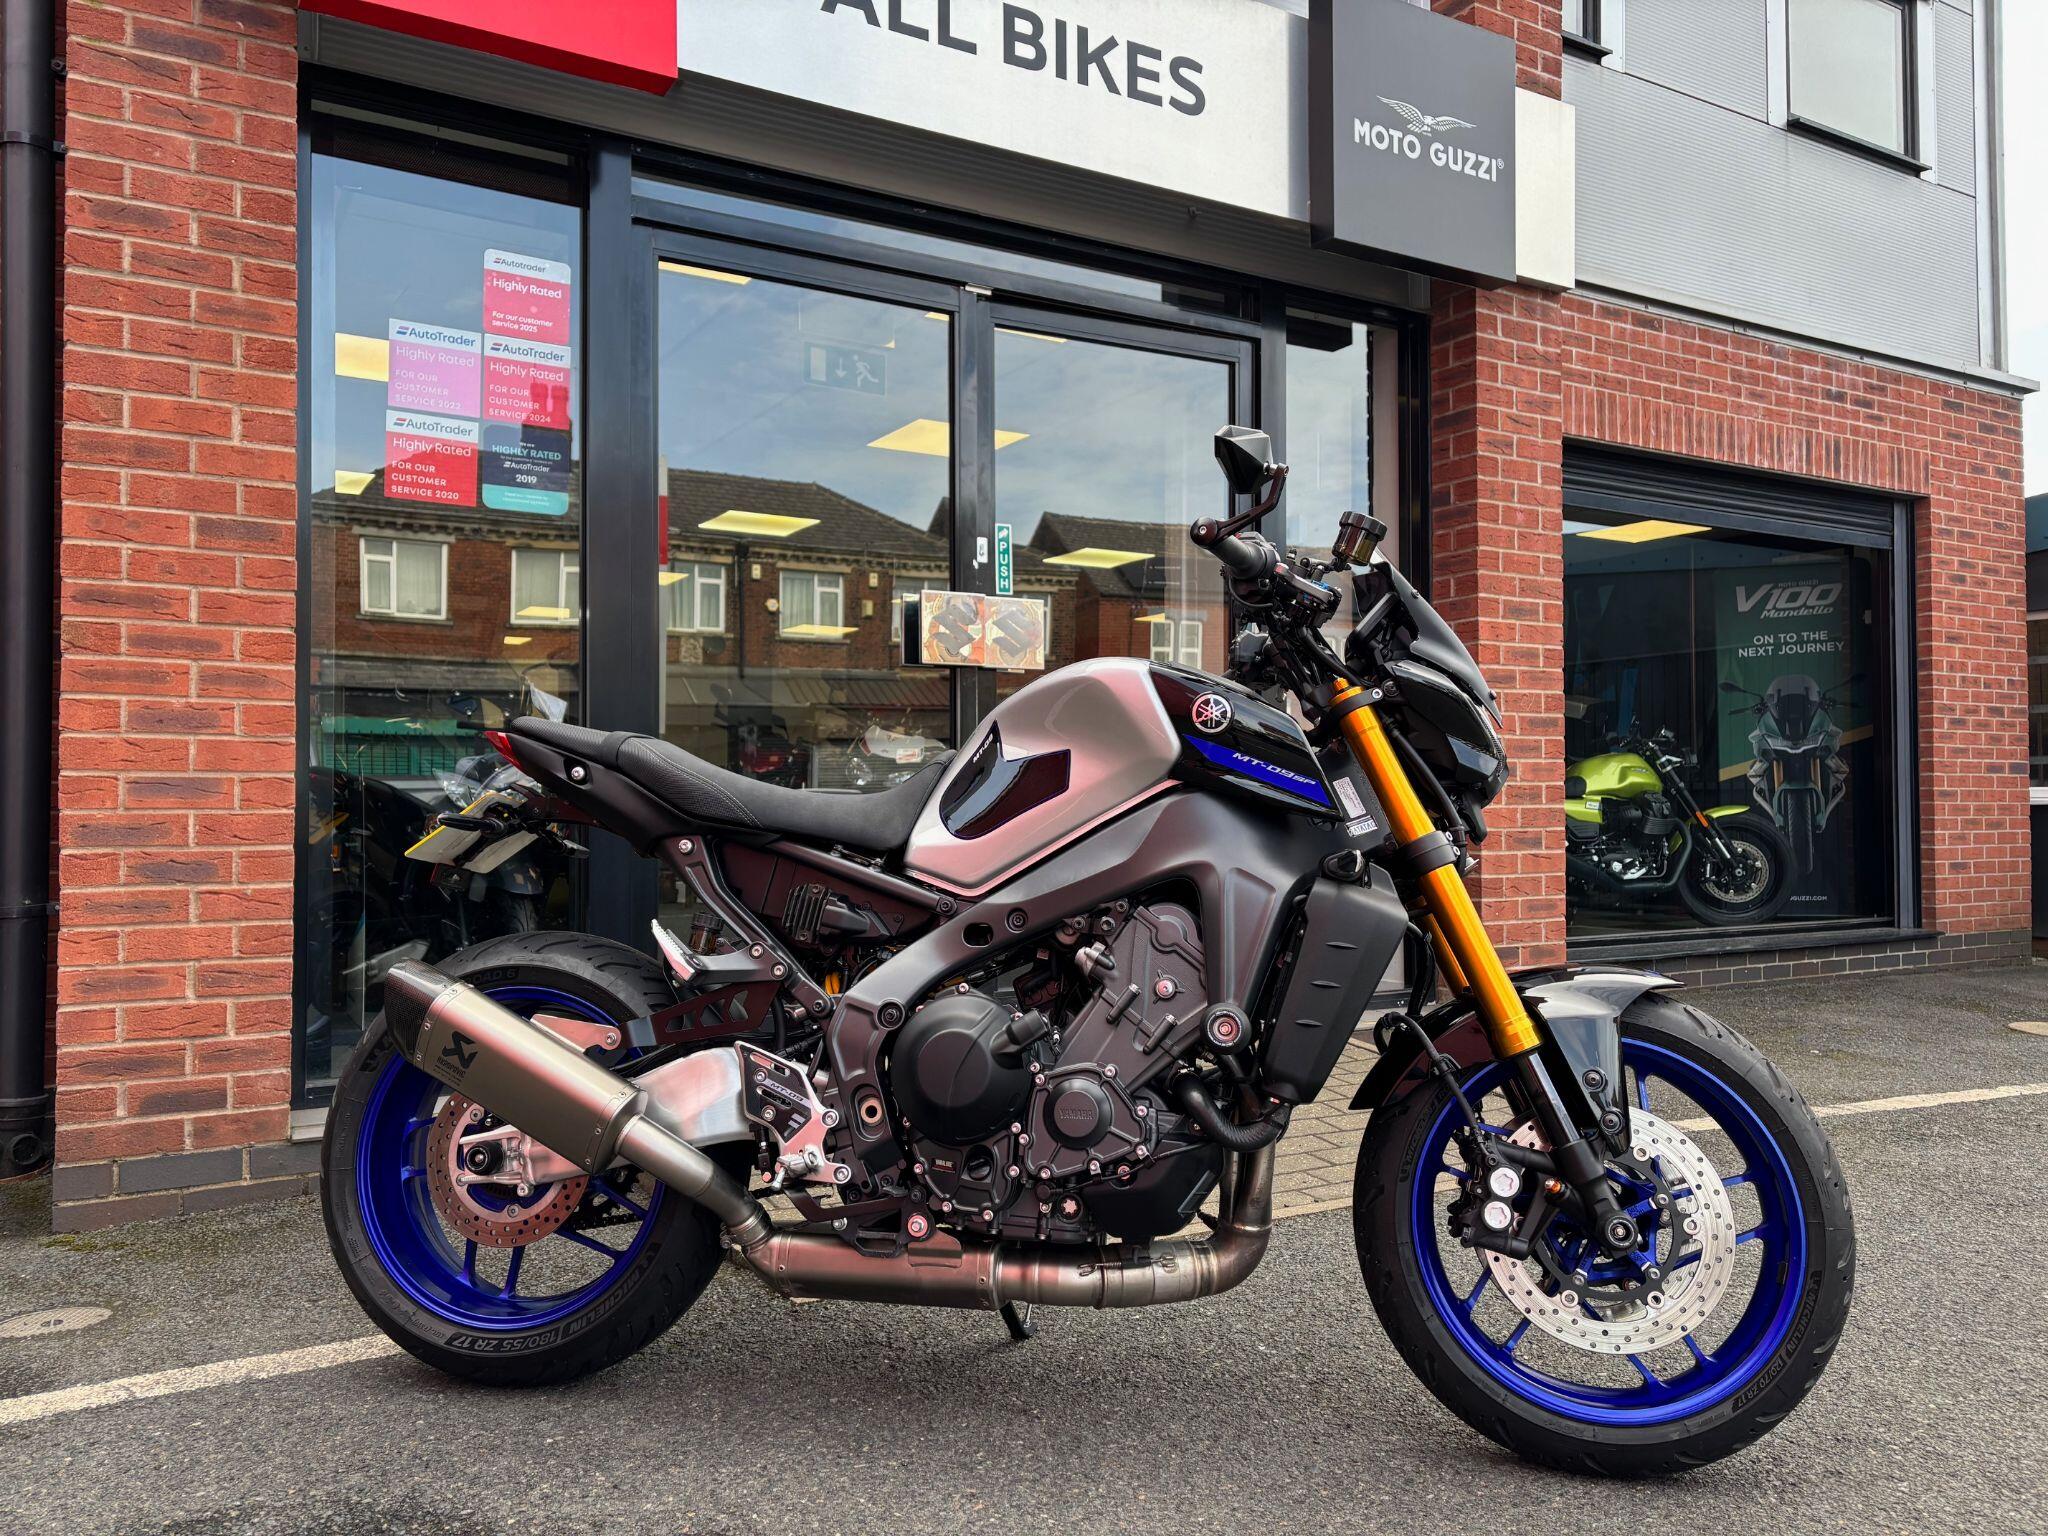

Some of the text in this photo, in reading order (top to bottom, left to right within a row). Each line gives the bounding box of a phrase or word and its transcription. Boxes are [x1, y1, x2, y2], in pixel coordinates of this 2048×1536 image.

[1003, 3, 1206, 117] BIKES
[1353, 117, 1422, 160] MOTO
[493, 277, 562, 299] Highly Rated
[492, 320, 519, 329] service
[518, 315, 553, 327] customer
[409, 327, 476, 347] AutoTrader
[396, 345, 475, 367] Highly Rated
[502, 344, 565, 361] AutoTrader
[395, 369, 438, 382] FOR OUR
[490, 361, 564, 382] Highly Rated
[394, 382, 449, 396] CUSTOMER
[489, 384, 529, 396] FOR OUR
[394, 394, 435, 406] SERVICE
[489, 396, 540, 410] CUSTOMER
[489, 408, 551, 423] SERVICE 2024
[406, 418, 473, 436] AutoTrader
[393, 437, 472, 457] Highly Rated
[492, 444, 529, 456] HIGHLY
[530, 450, 562, 460] RATED
[391, 460, 436, 473] FOR OUR
[510, 462, 550, 473] AutoTrader
[391, 472, 447, 487] CUSTOMER
[515, 474, 537, 484] 2019
[391, 485, 459, 500] SERVICE 2020
[999, 541, 1009, 589] PUSH
[1736, 582, 1842, 613] V100
[1760, 606, 1834, 619] Mandello
[1753, 630, 1828, 645] ON TO THE
[1738, 641, 1844, 658] NEXT JOURNEY
[452, 1267, 641, 1351] MICHELIN 180/55 ZR 17
[1787, 1286, 1816, 1352] MICHELIN
